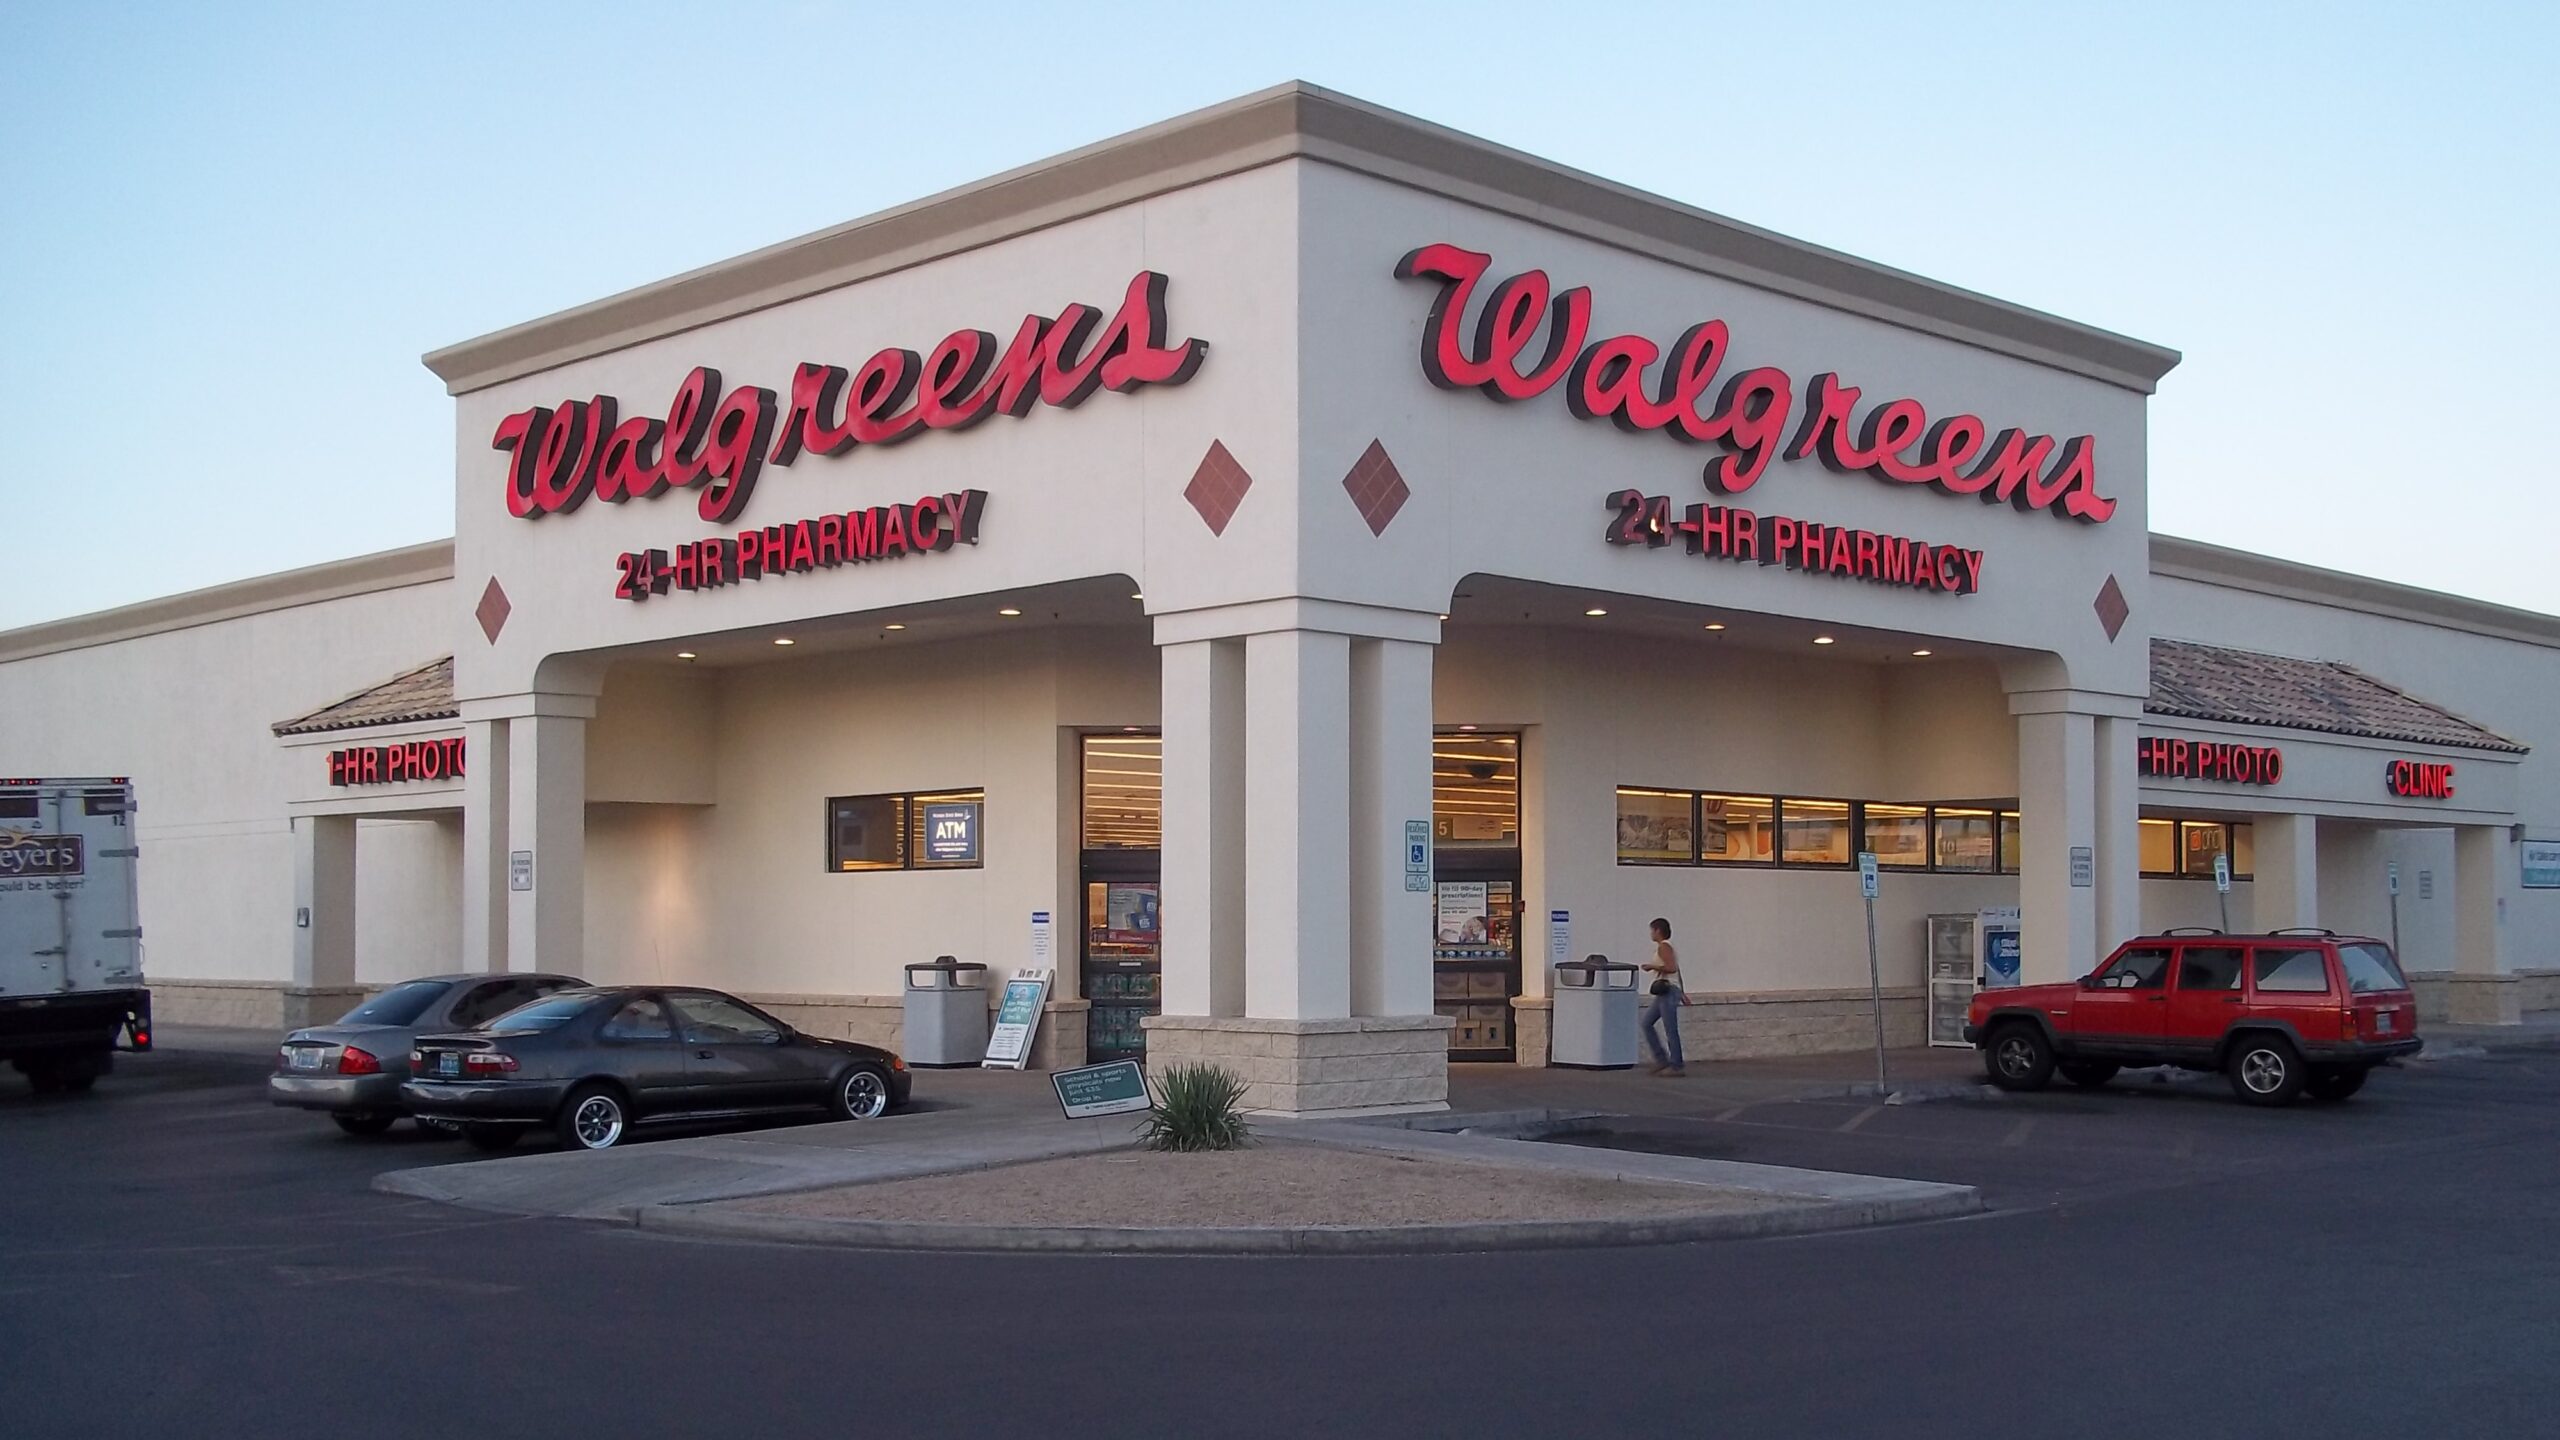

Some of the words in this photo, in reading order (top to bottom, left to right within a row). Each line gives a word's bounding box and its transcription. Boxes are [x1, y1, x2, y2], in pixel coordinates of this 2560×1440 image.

[493, 269, 1209, 523] Walgreens
[1394, 243, 2117, 525] Walgreens
[616, 537, 732, 600] 24-HR
[737, 489, 987, 585] PHARMACY
[1606, 489, 1758, 561] 24-HR
[1772, 516, 1984, 595] PHARMACY
[326, 746, 380, 788] 1-HR
[2198, 741, 2283, 785] PHOTO
[2393, 759, 2455, 799] CLINIC
[936, 820, 966, 839] ATM
[1439, 821, 1448, 836] 5
